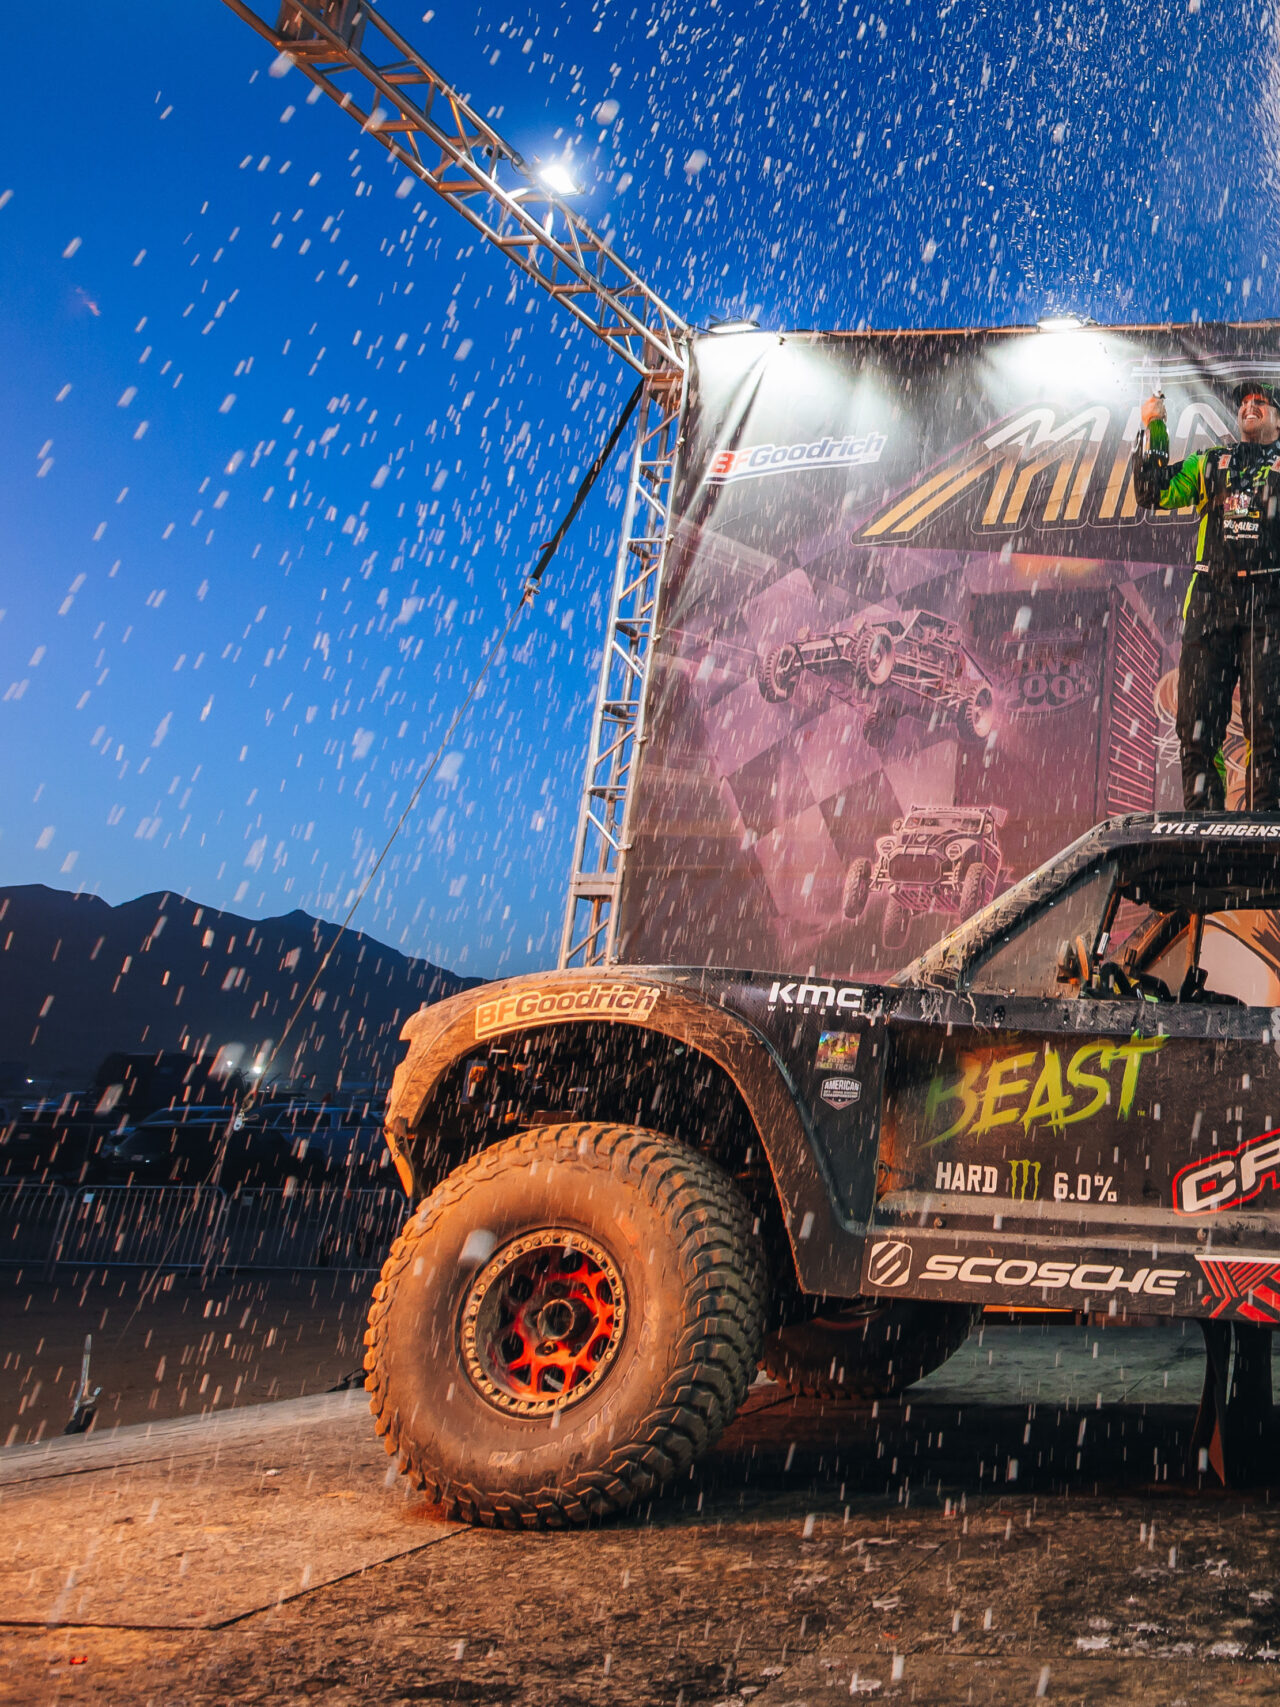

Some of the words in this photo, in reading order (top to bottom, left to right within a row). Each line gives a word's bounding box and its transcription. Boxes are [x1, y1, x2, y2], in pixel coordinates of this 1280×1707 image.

[710, 436, 884, 474] BFGoodrich
[1151, 822, 1199, 836] KYLE
[477, 988, 656, 1029] BFGoodrich
[767, 1004, 858, 1018] WHEELS
[824, 1079, 860, 1091] AMERICAN
[917, 1028, 1171, 1150] BEAST
[935, 1161, 998, 1194] HARD
[1053, 1171, 1118, 1203] 6.0%
[918, 1254, 1186, 1296] SCOSCHE
